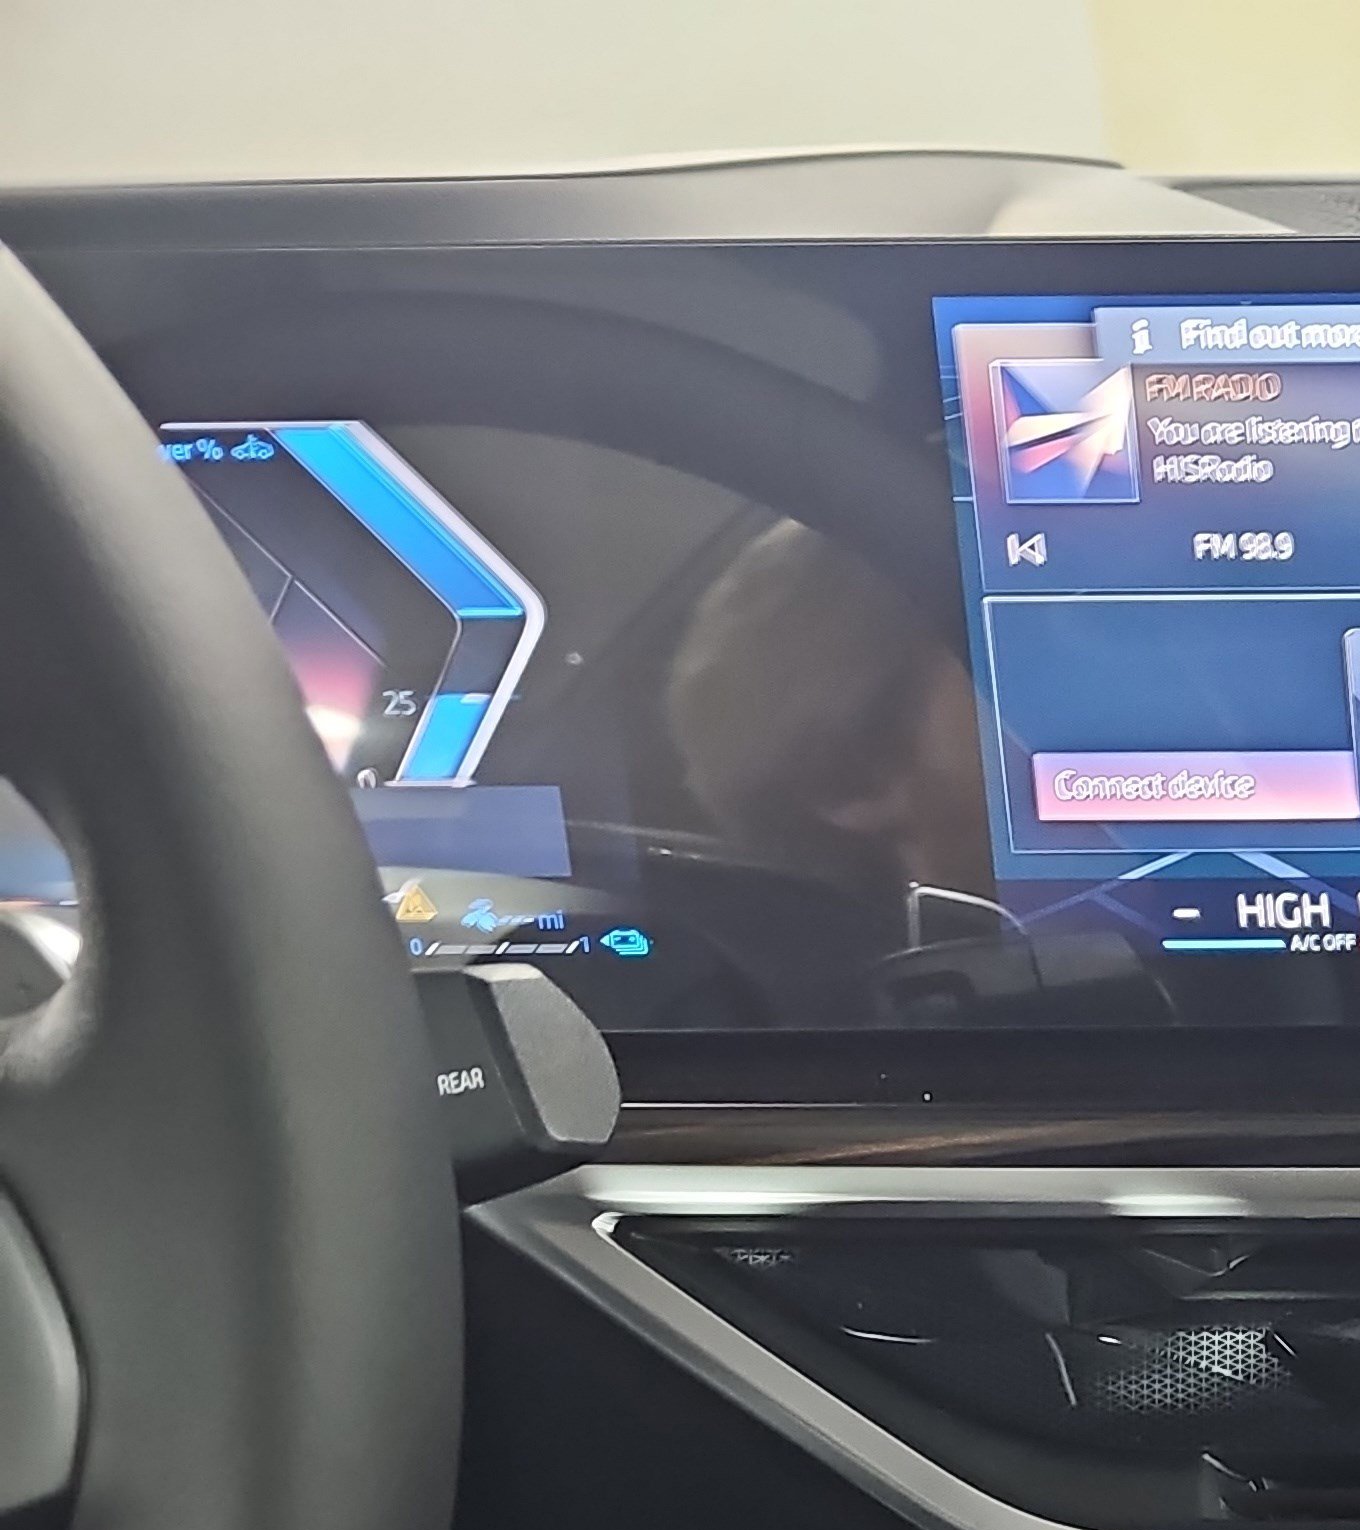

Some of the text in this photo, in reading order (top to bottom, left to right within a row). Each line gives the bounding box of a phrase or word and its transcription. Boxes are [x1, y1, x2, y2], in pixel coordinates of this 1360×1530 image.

[1180, 319, 1248, 350] Find
[1249, 321, 1300, 349] out
[1145, 372, 1283, 401] FM RADIO
[1147, 416, 1200, 446] You
[1200, 418, 1245, 445] are
[1245, 415, 1352, 450] listening
[1152, 455, 1274, 483] HISRadio
[1193, 531, 1295, 560] FM 98.9
[382, 690, 417, 717] 25
[1054, 769, 1256, 801] Connect device
[1237, 890, 1332, 929] HIGH
[1290, 932, 1357, 952] A/C OFF
[436, 1065, 485, 1097] REAR
